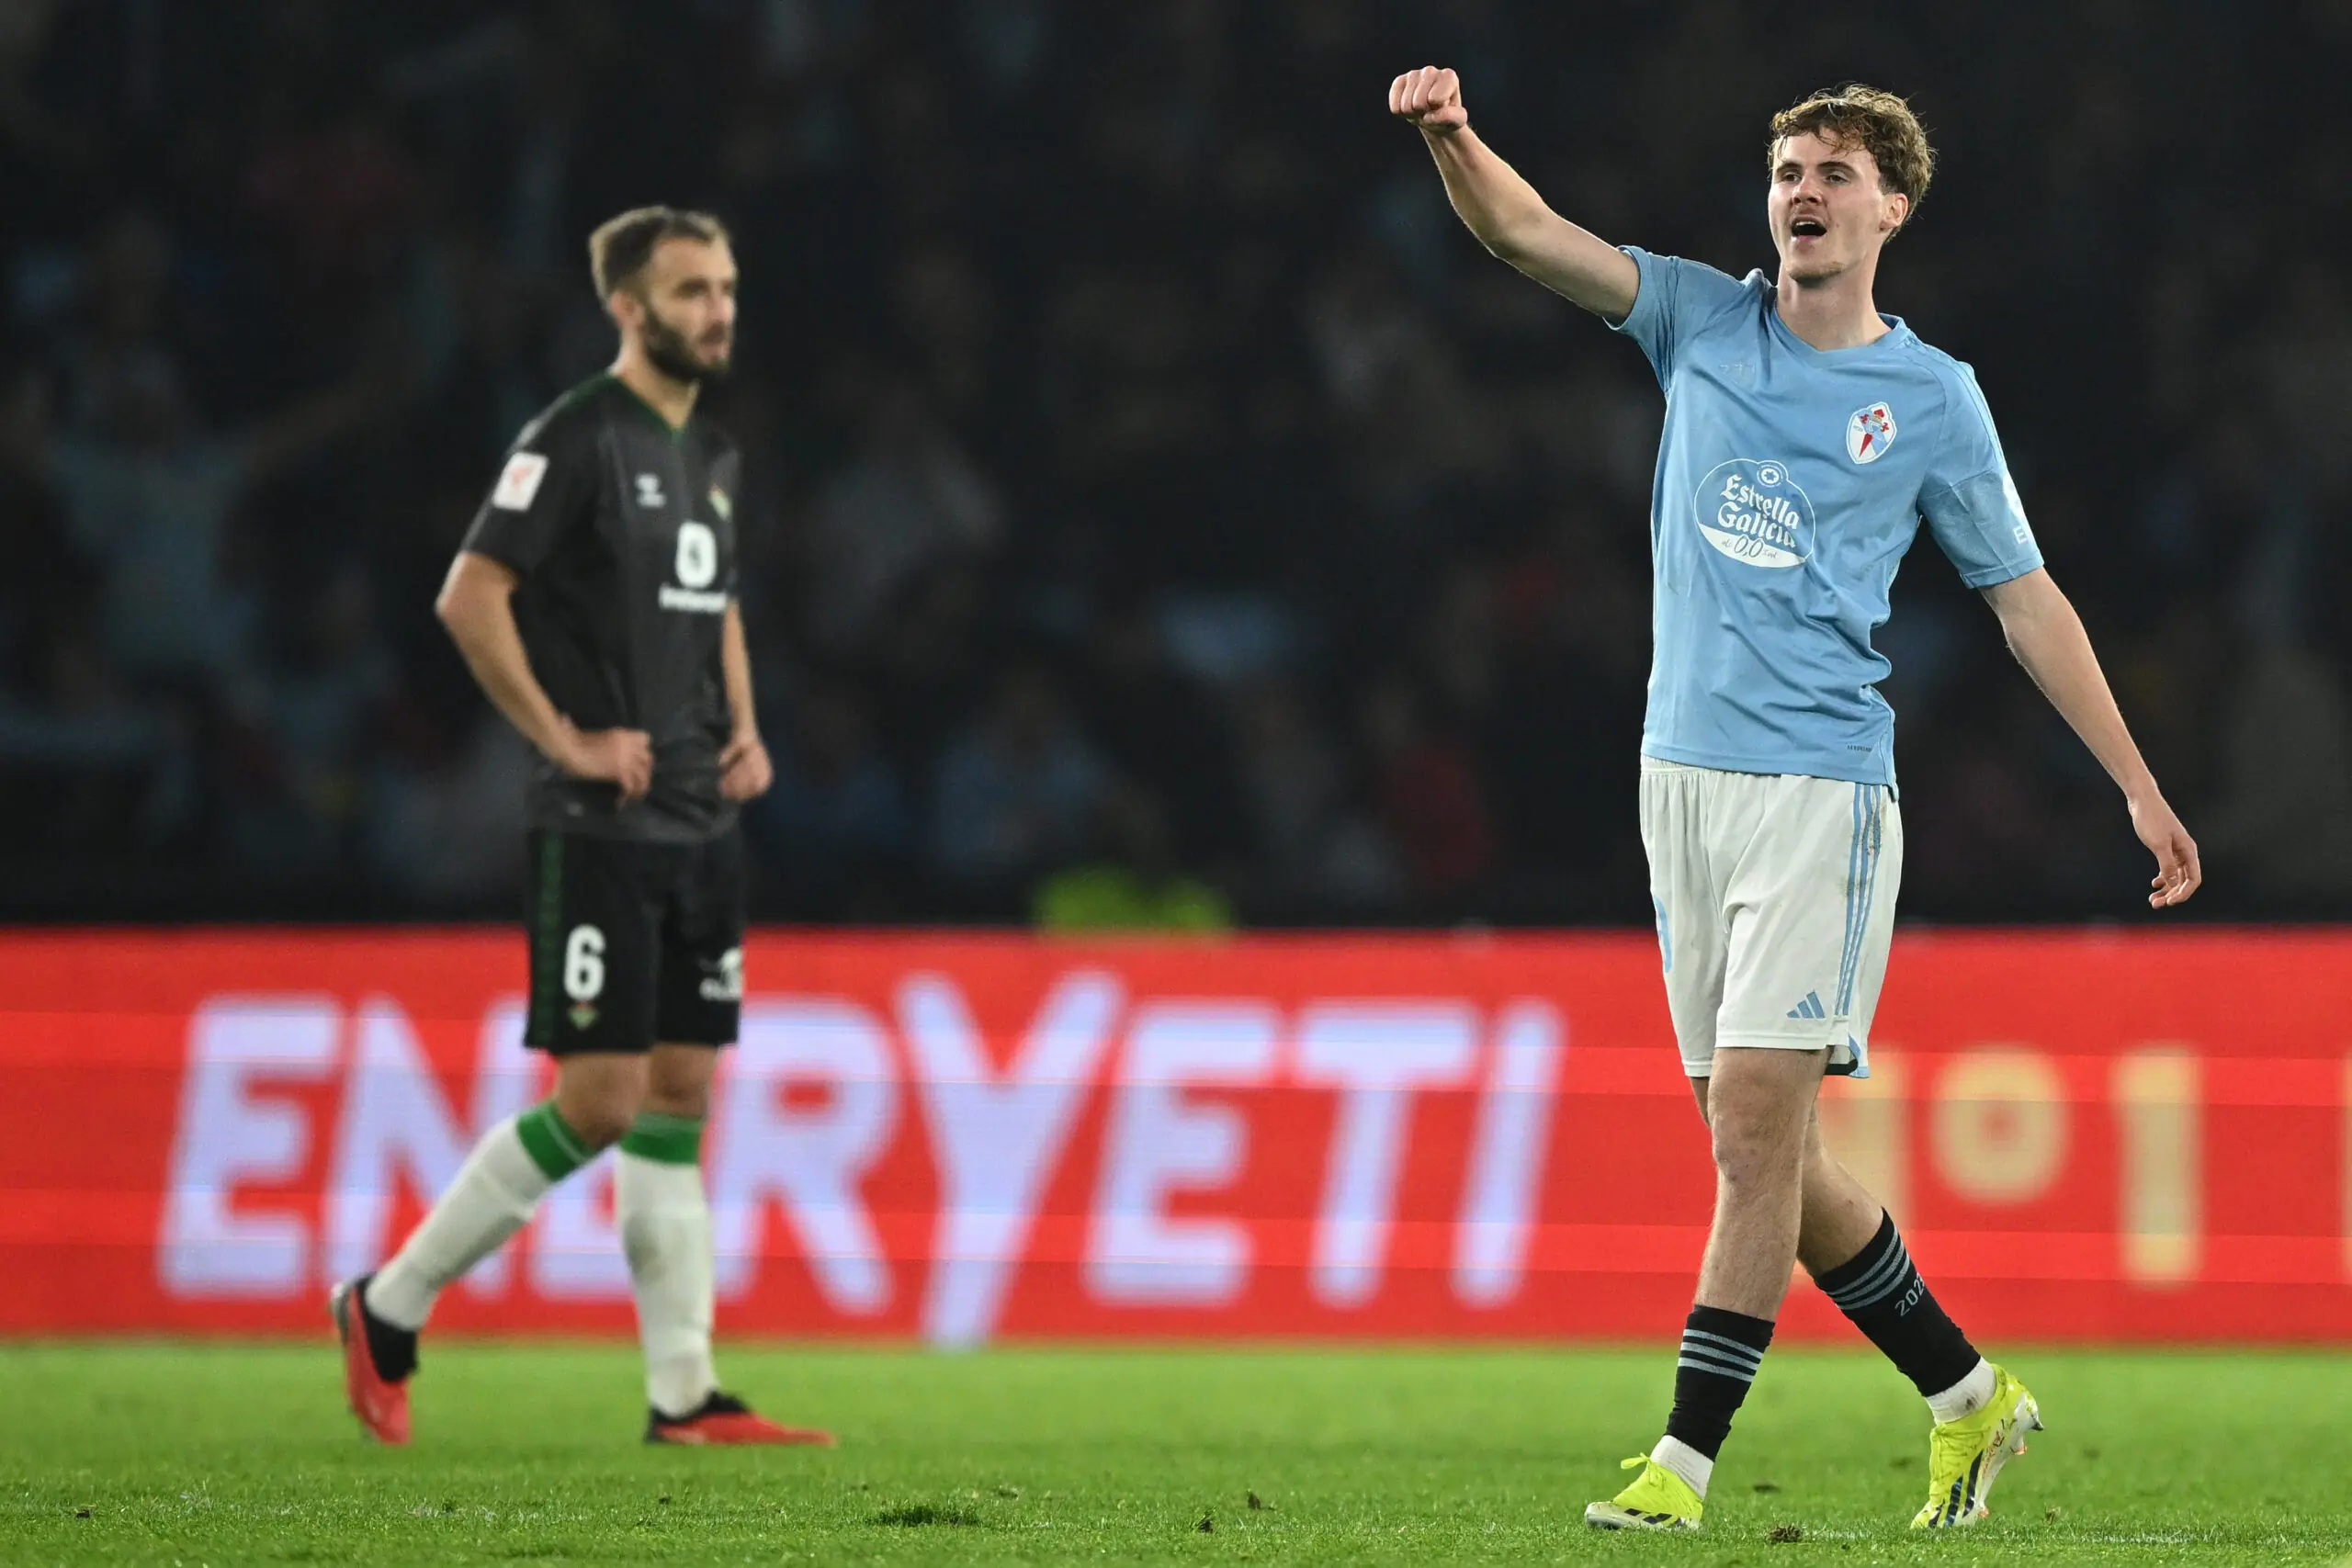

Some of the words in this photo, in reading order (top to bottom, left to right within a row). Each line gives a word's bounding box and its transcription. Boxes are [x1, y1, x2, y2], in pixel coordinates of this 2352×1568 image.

[1717, 501, 1796, 548] Galicia
[1720, 474, 1800, 529] Estrella
[1734, 535, 1764, 558] 0,0
[563, 924, 606, 1001] 6
